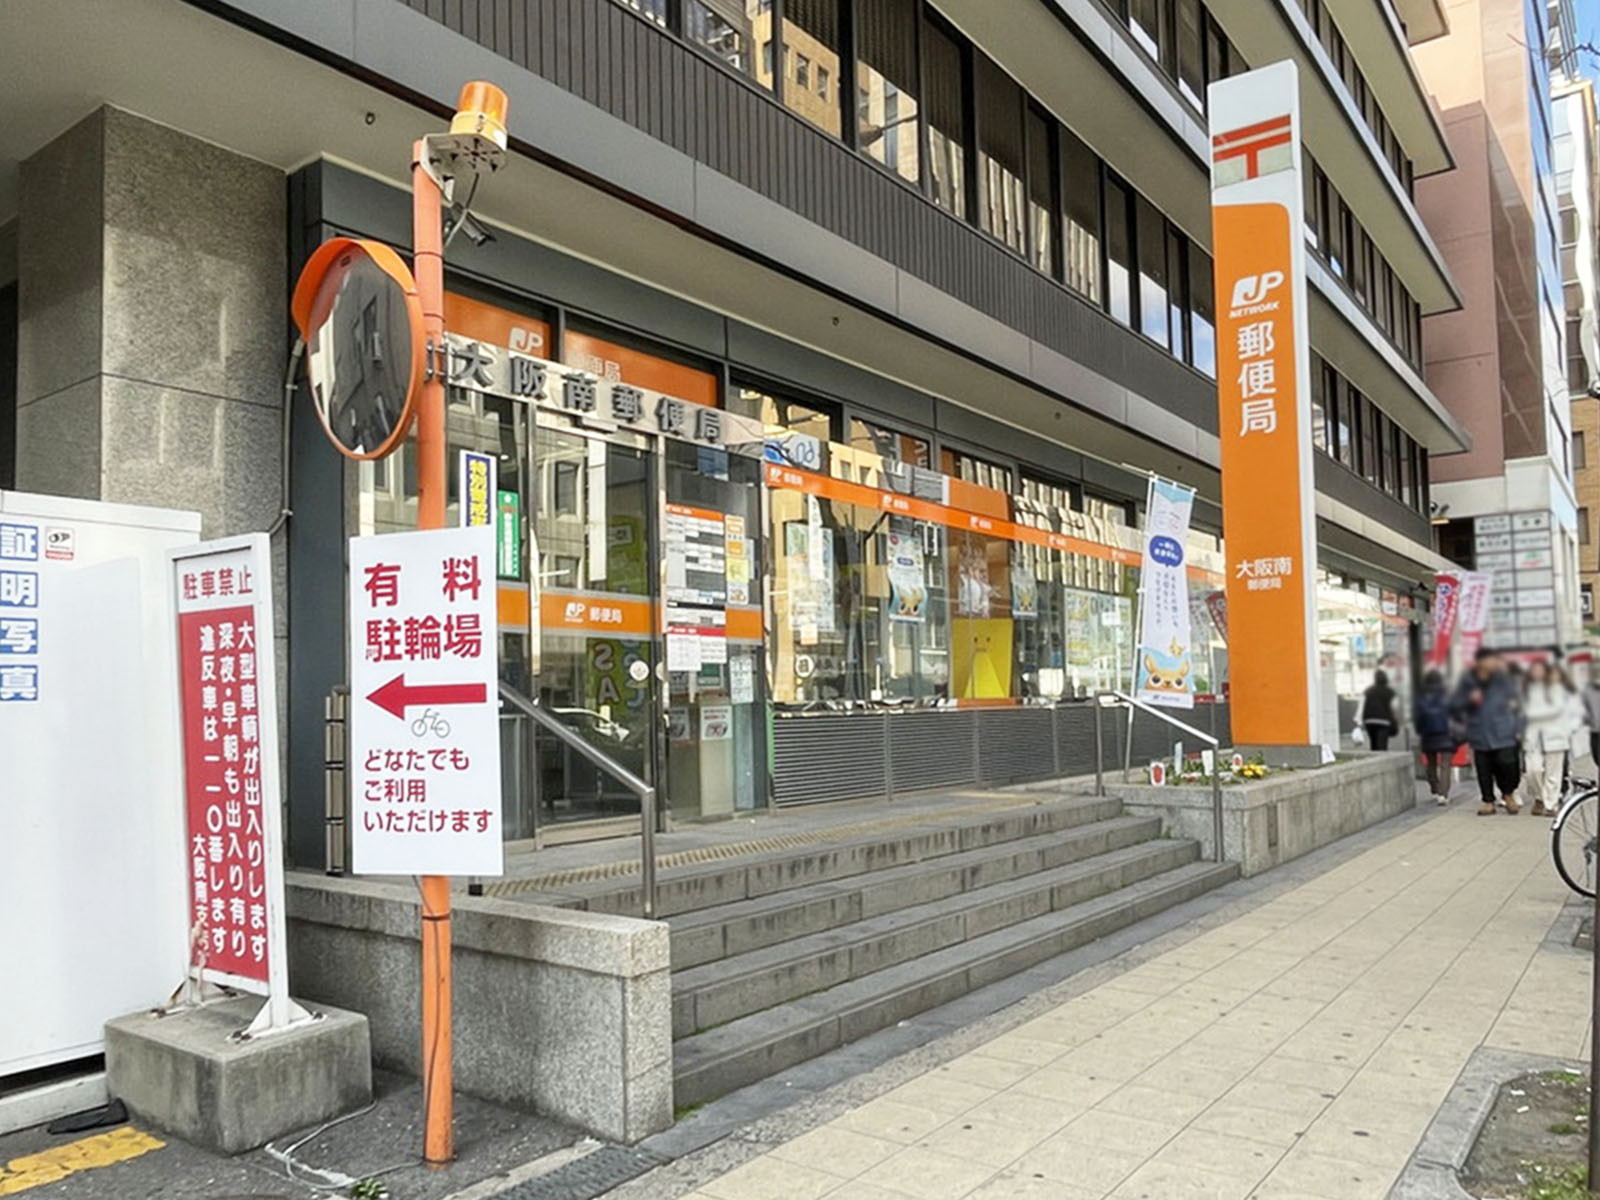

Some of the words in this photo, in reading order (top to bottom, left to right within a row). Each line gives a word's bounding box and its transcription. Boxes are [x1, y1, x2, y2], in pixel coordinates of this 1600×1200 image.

[1229, 301, 1280, 319] NETWORK
[448, 342, 723, 442] 大阪南郵便局
[1237, 320, 1277, 437] 郵便局
[183, 564, 253, 600] 駐車禁止
[1236, 556, 1292, 579] 大阪南
[0, 523, 37, 700] 証明写真
[365, 613, 482, 663] 駐輪場
[364, 748, 470, 772] どなたでも
[364, 778, 426, 803] ご利用
[363, 809, 493, 833] いただけます
